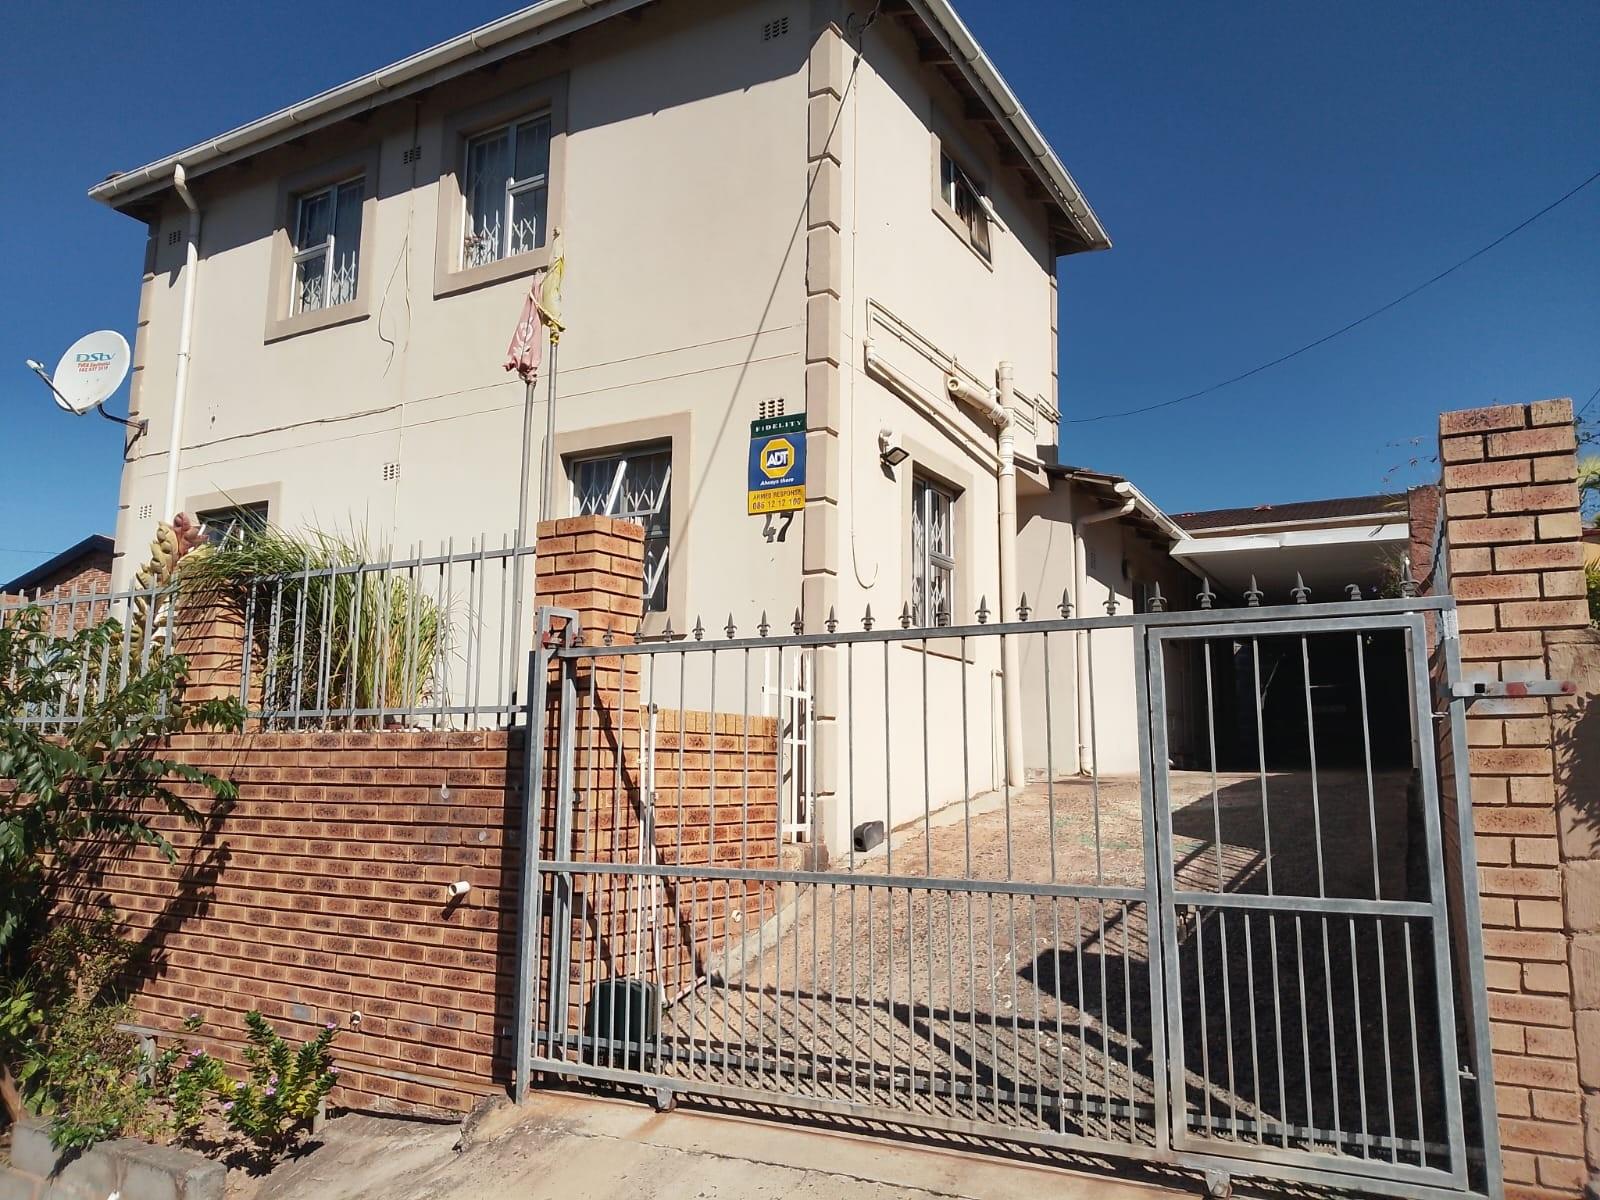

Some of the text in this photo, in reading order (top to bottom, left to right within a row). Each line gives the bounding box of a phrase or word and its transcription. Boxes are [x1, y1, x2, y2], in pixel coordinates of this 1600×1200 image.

[76, 352, 116, 362] DStv
[755, 420, 801, 432] FIDELITY
[767, 451, 788, 466] ADT
[752, 489, 801, 501] ARMED RESPONSE
[752, 497, 802, 510] 086 12 12 100
[762, 511, 794, 543] 47
